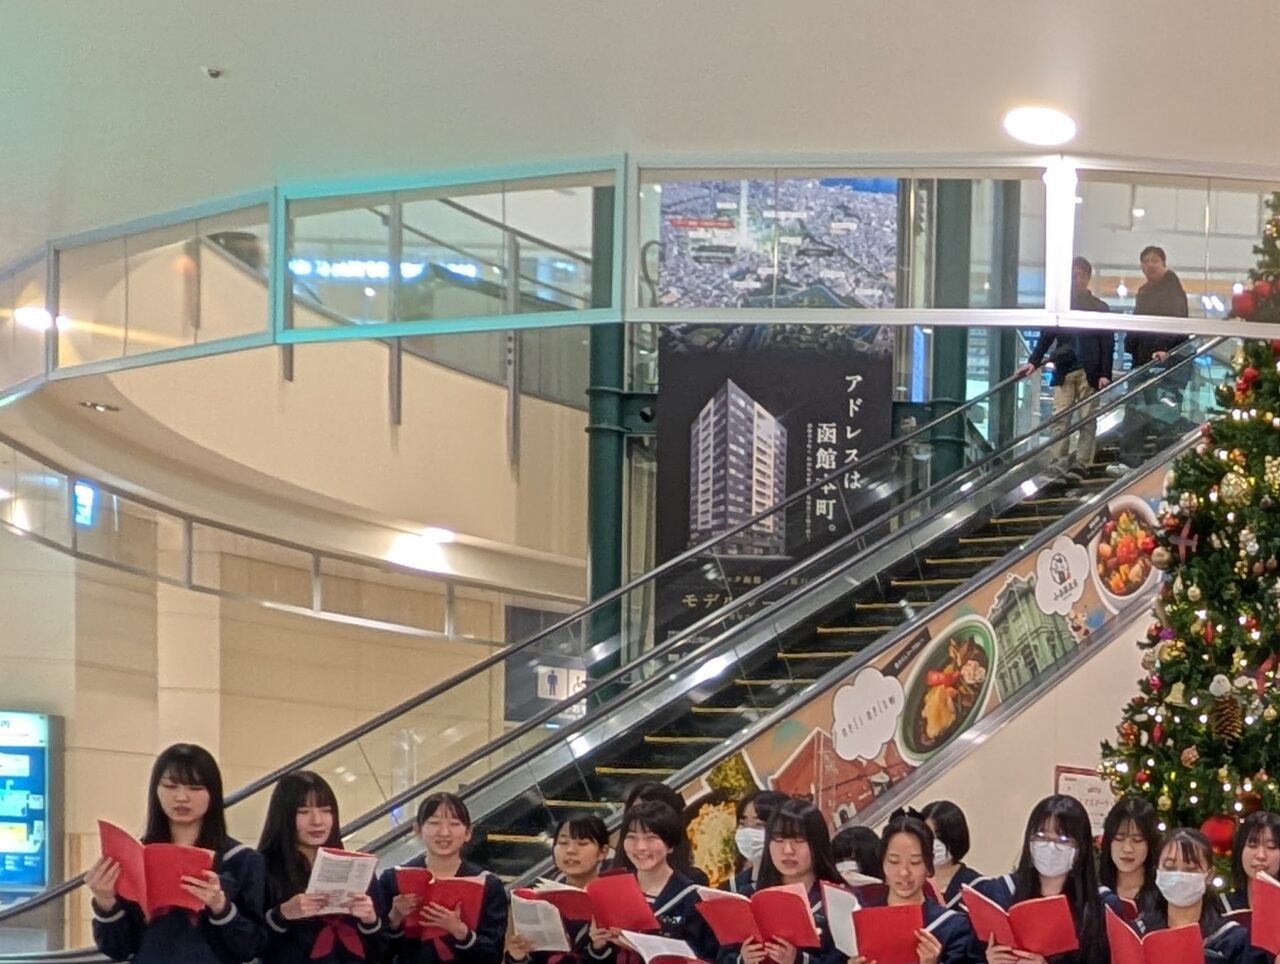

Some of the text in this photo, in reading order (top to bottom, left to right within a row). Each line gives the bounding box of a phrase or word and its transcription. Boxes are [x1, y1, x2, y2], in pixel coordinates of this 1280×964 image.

[844, 374, 863, 489] アドレスは
